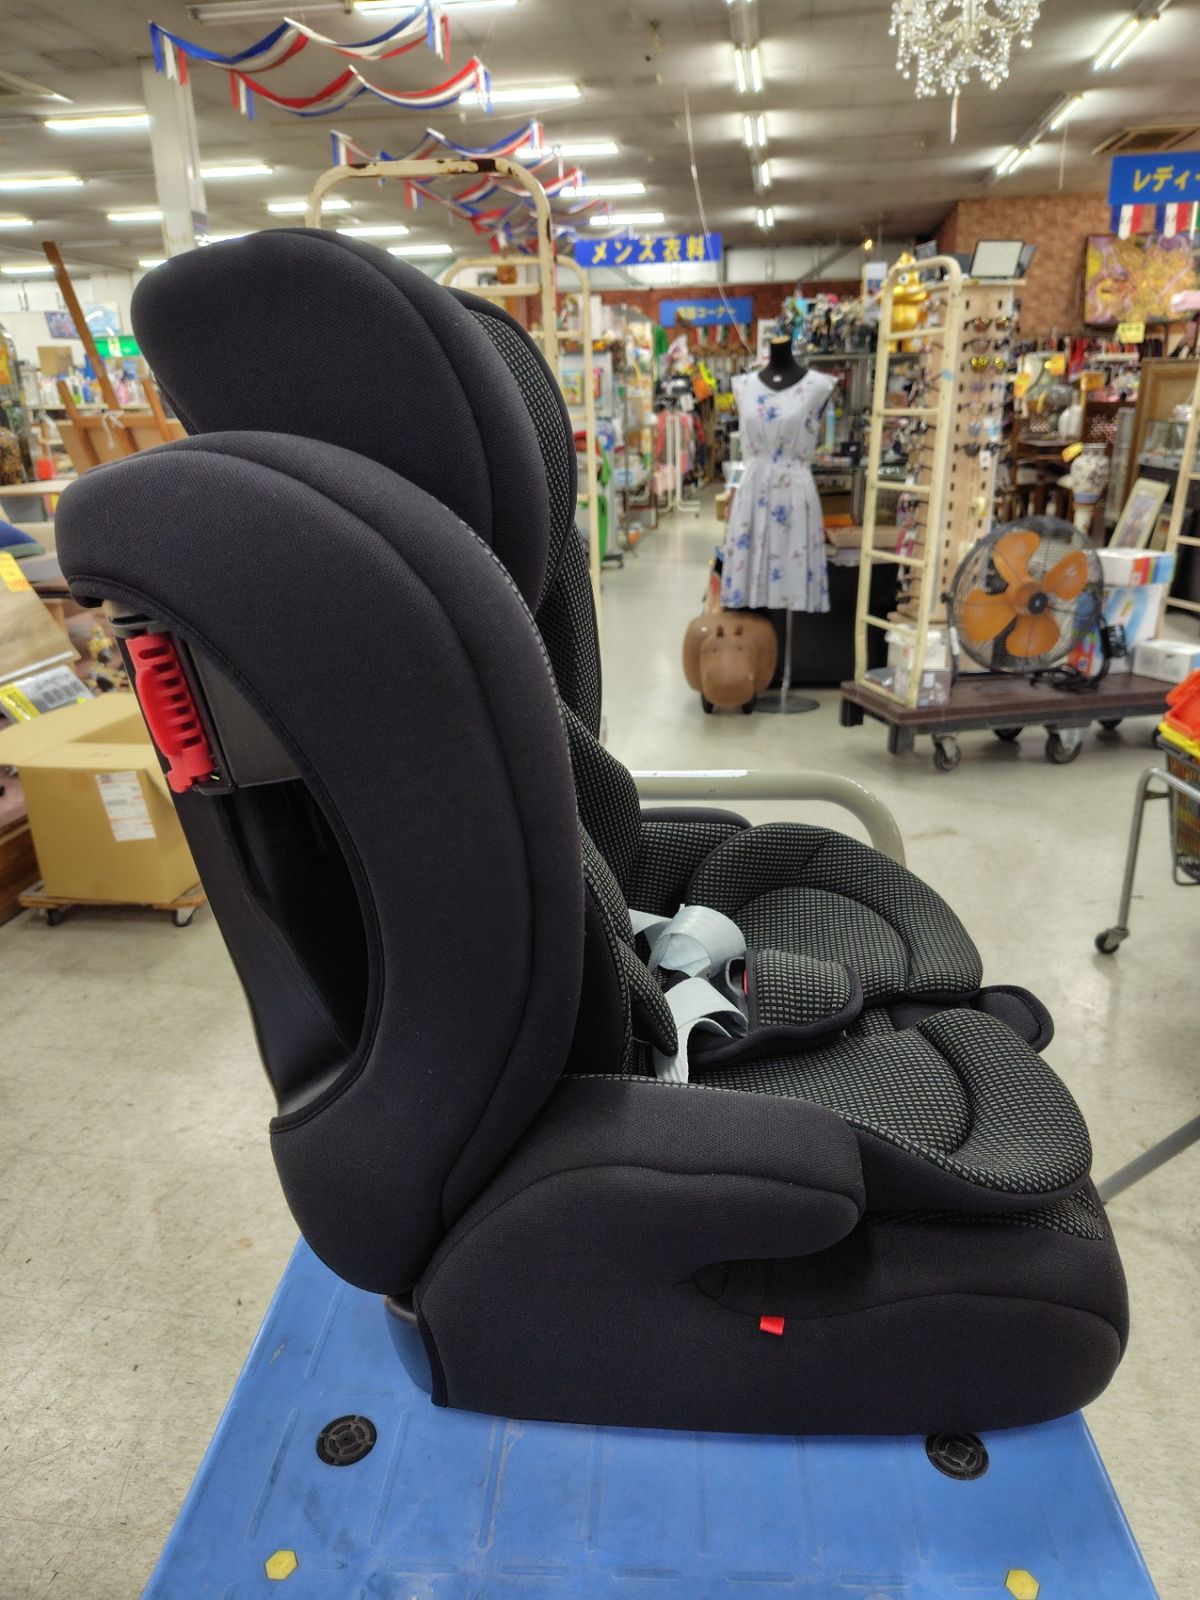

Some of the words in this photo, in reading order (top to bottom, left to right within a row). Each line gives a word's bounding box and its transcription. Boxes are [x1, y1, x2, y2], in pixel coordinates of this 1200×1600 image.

[591, 235, 705, 264] メンズ衣料
